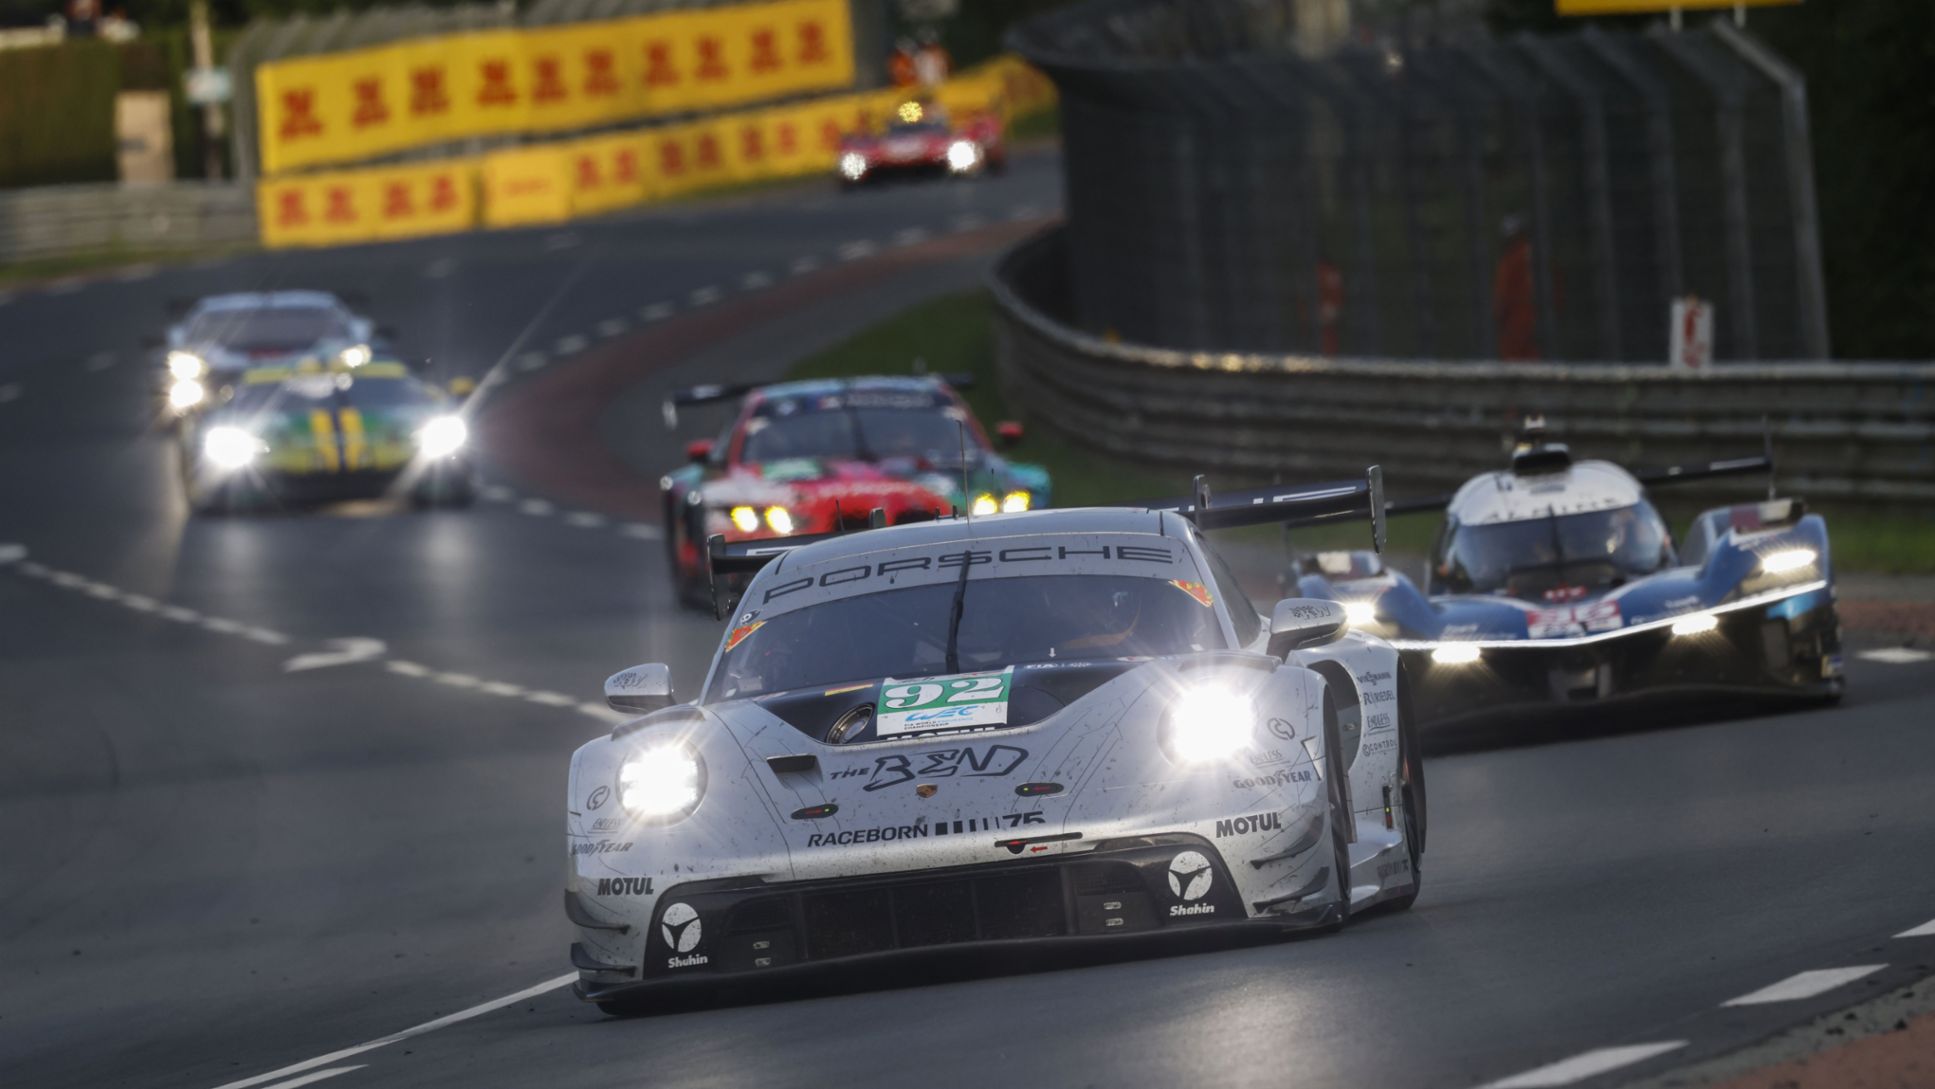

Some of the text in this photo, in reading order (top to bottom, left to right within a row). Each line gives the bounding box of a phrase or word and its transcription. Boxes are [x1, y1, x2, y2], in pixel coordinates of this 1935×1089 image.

[763, 545, 1173, 605] PORSCHE
[884, 677, 1004, 709] 92
[905, 705, 979, 721] WEC
[830, 744, 1030, 792] THE BEND
[1232, 770, 1312, 789] GOODYEAR
[808, 824, 928, 848] RACEBORN
[1216, 812, 1282, 838] MOTUL
[597, 877, 655, 896] MOTUL
[1169, 902, 1215, 917] Shahin
